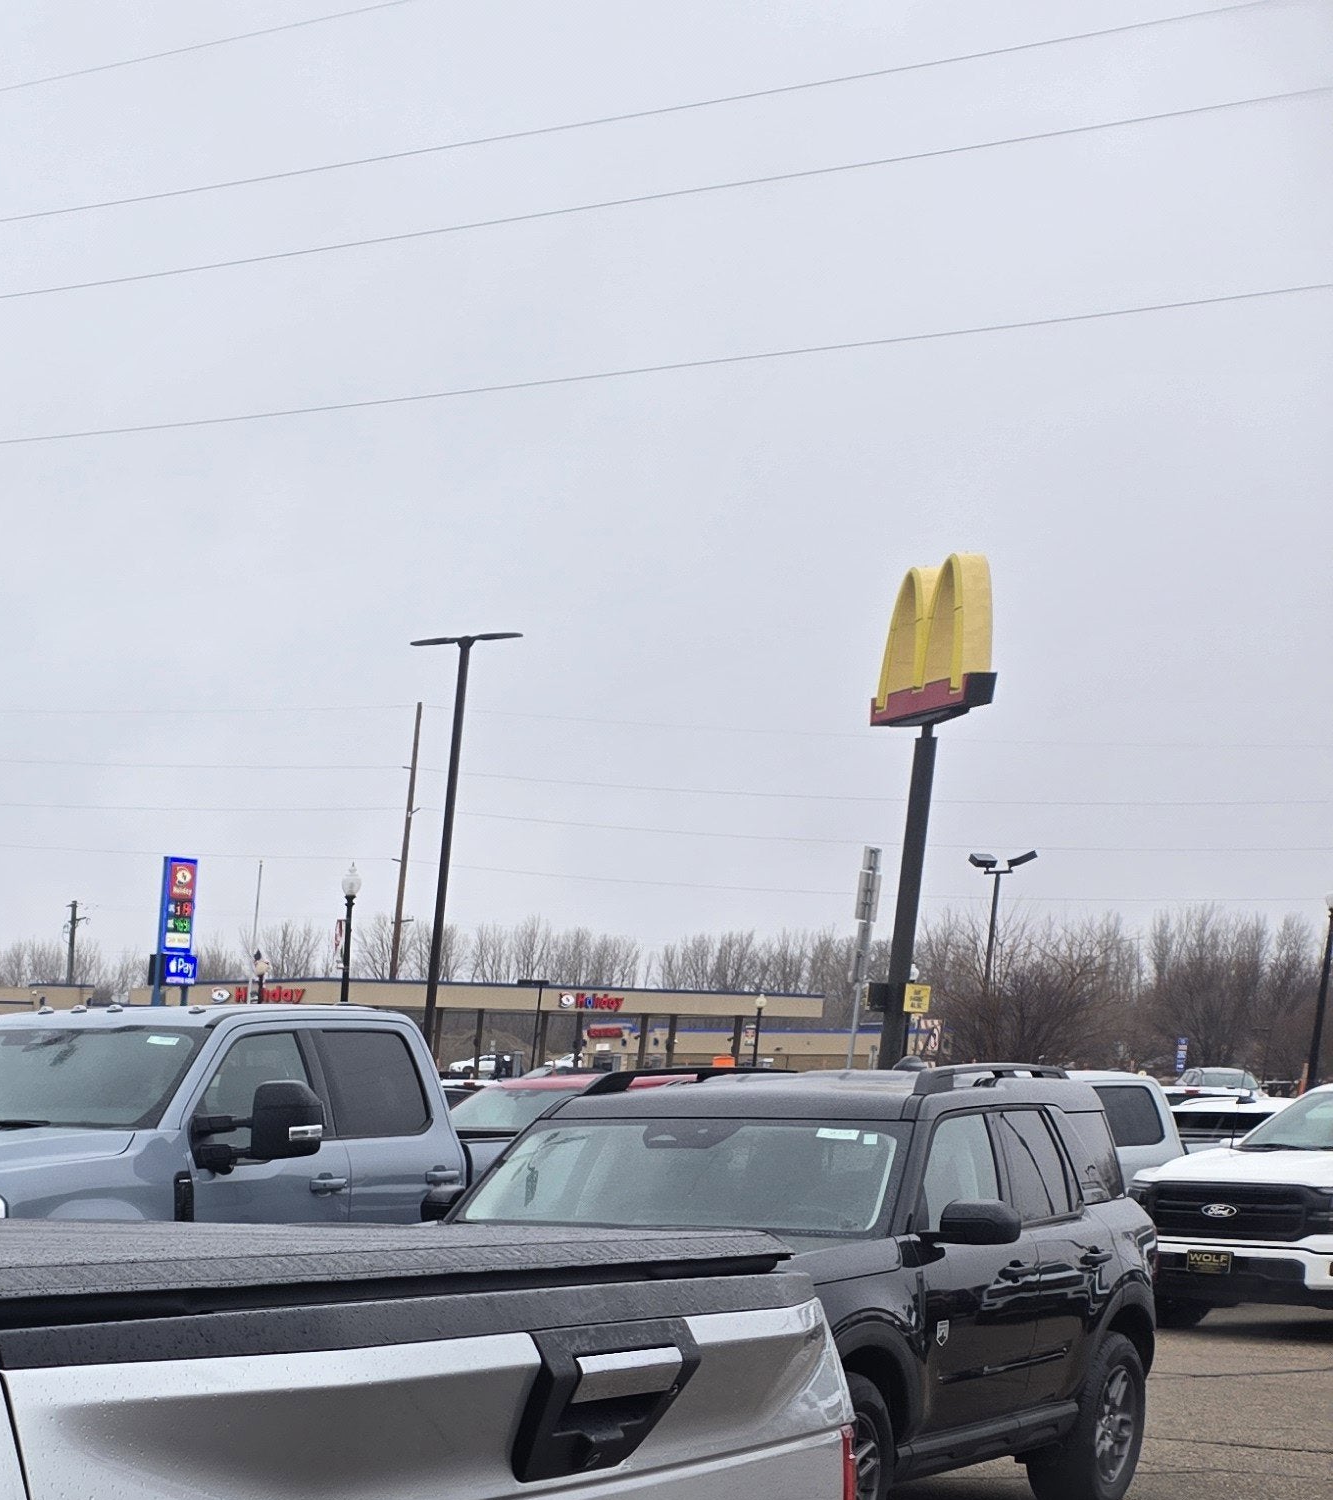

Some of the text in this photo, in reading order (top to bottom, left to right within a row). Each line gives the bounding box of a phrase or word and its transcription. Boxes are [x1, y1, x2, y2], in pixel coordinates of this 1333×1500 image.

[177, 957, 194, 977] Pay
[575, 993, 624, 1012] Holiday
[1189, 1253, 1229, 1263] WOLF
